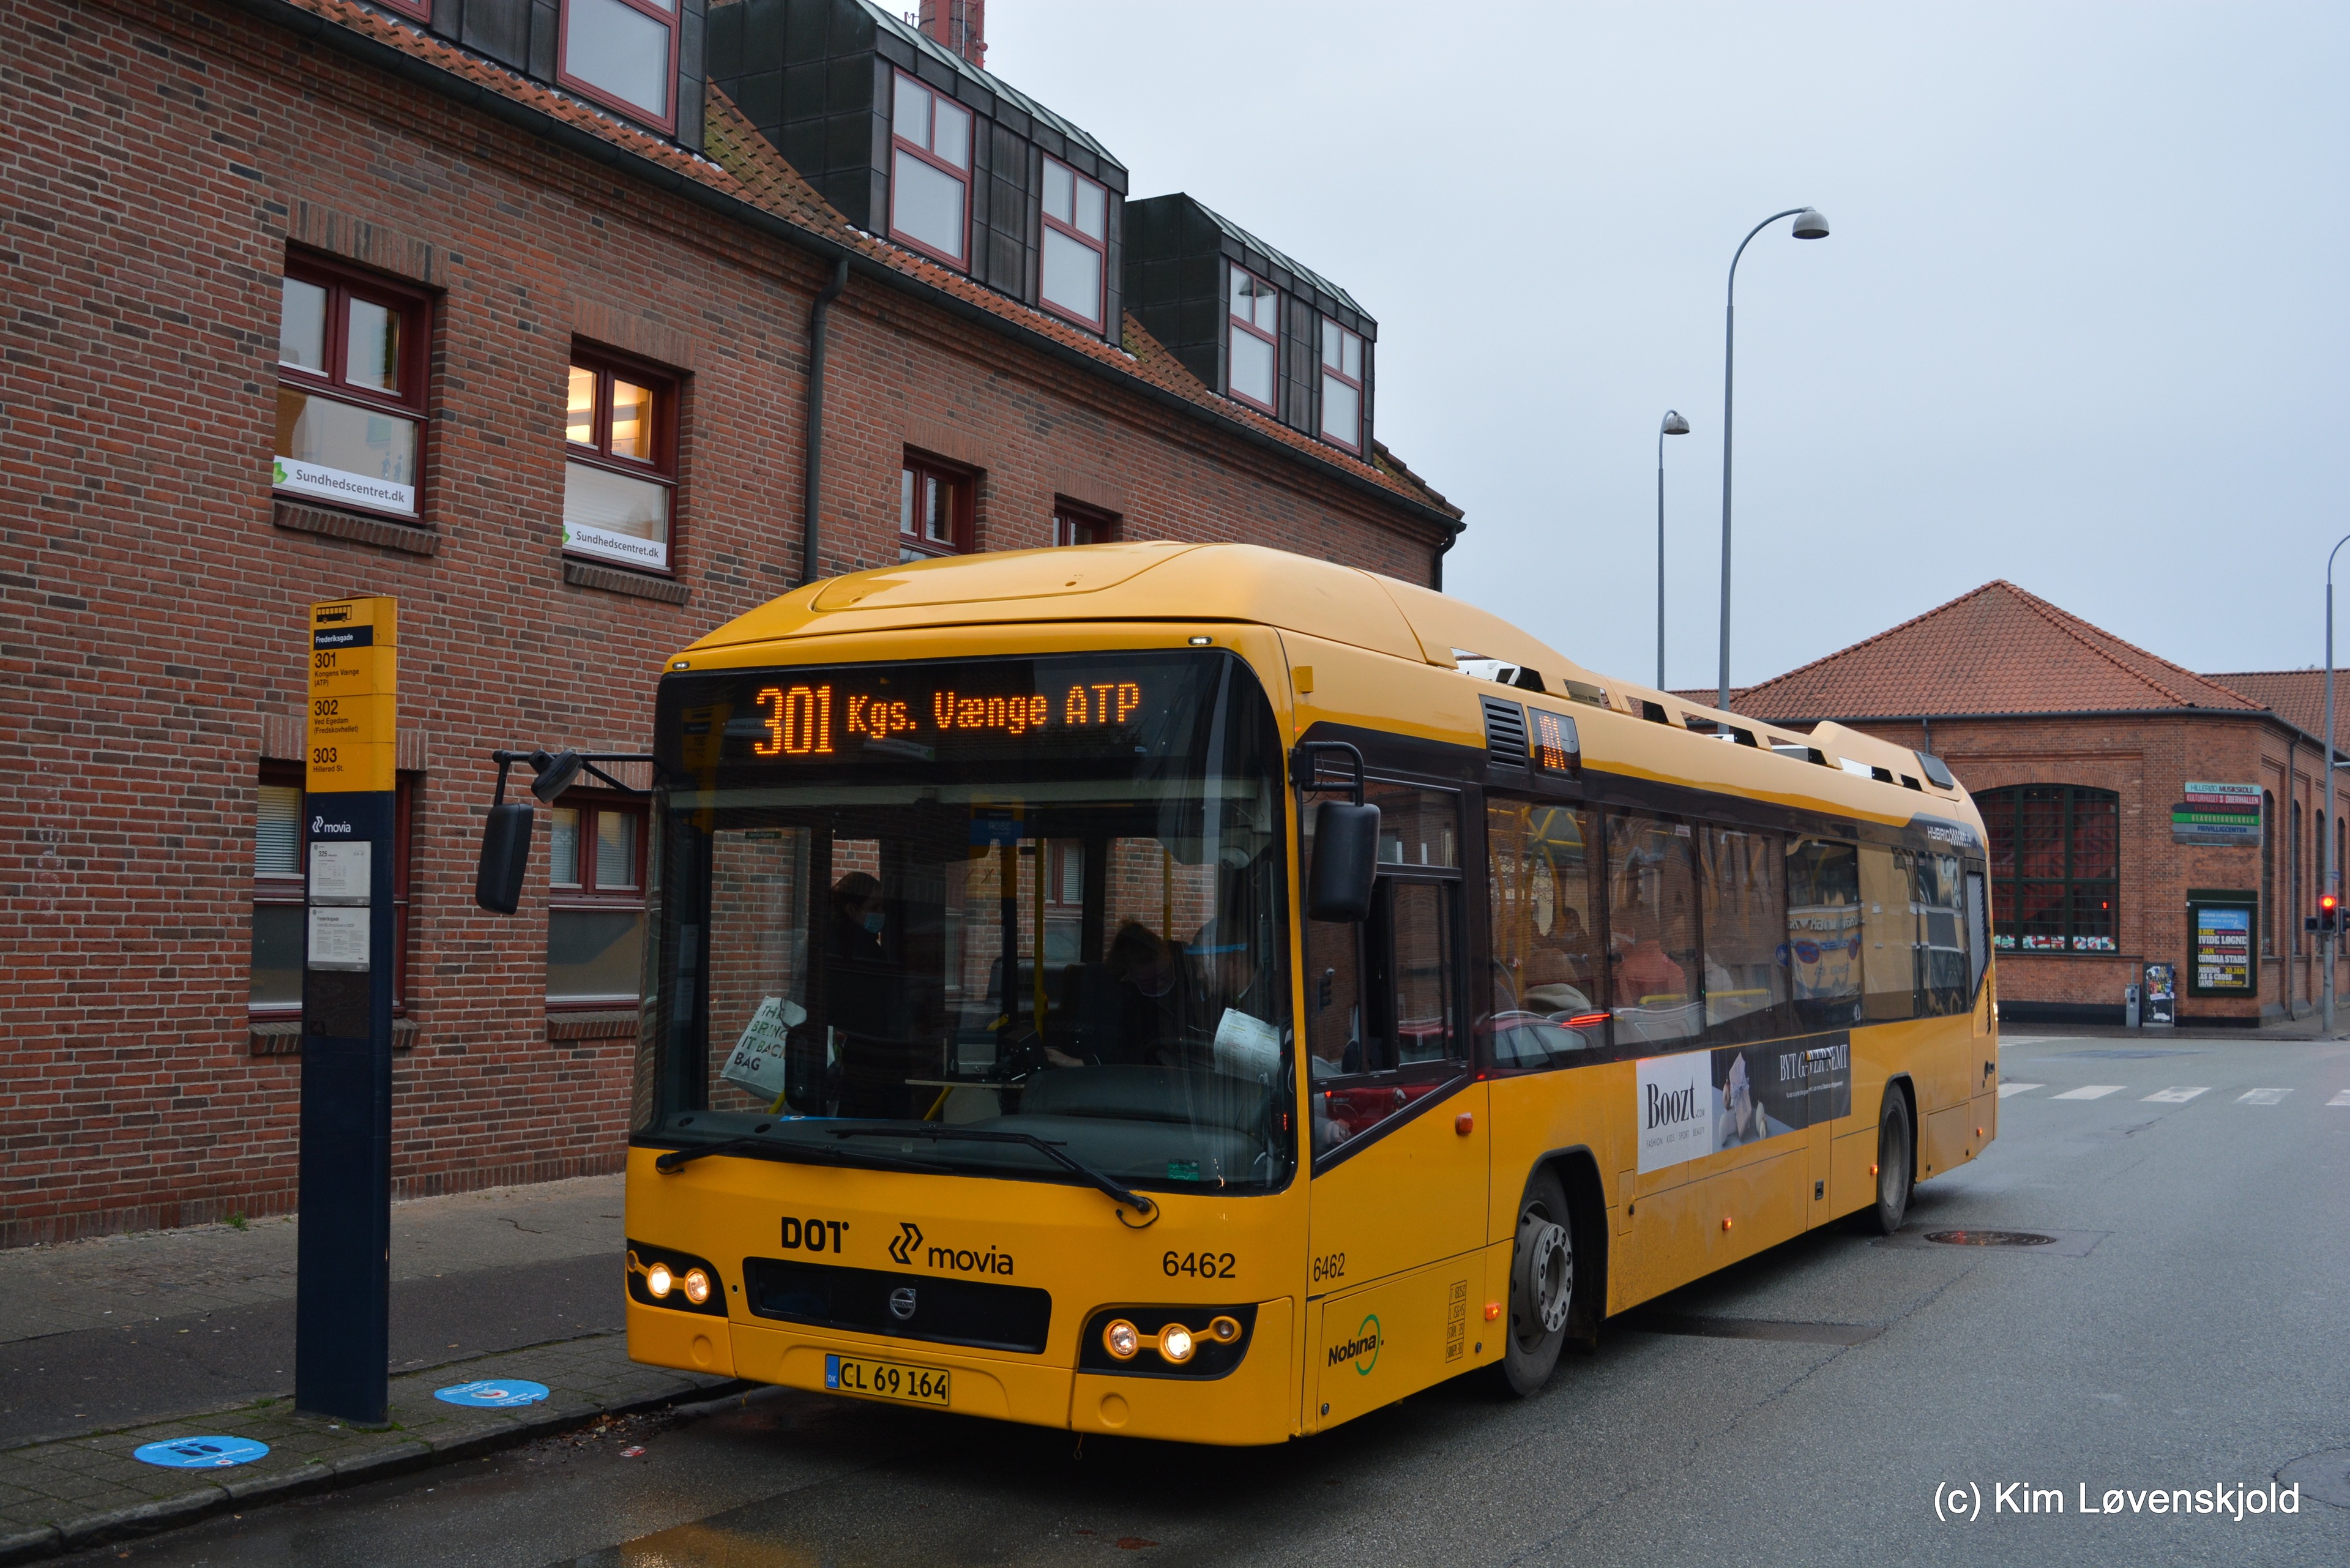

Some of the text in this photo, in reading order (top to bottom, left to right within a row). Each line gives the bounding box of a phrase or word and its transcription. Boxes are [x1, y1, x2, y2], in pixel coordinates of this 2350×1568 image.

[296, 469, 405, 502] Sundhedscentret.dk
[576, 531, 658, 558] Sundhedscentret.dk
[316, 634, 353, 643] Frederiksgade
[315, 652, 336, 668] 301
[315, 700, 338, 716] 302
[755, 685, 833, 755] 301
[849, 695, 916, 739] Kgs.
[934, 692, 1046, 734] Vænge
[1067, 683, 1139, 723] ATP
[313, 747, 337, 763] 303
[324, 821, 351, 832] movia
[1927, 826, 1950, 842] HYBRID
[742, 1036, 758, 1050] IT
[734, 1052, 761, 1071] BAG
[1780, 1053, 1796, 1081] BYT
[1826, 1044, 1848, 1072] NEMT
[1646, 1077, 1696, 1129] Boozt
[1646, 1137, 1663, 1148] FASHION
[1666, 1133, 1675, 1143] KIDS
[1679, 1130, 1689, 1140] SPORT
[781, 1217, 849, 1253] DOT
[928, 1245, 1013, 1275] movia
[1163, 1251, 1236, 1279] 6462
[1313, 1252, 1345, 1282] 6462
[1328, 1334, 1376, 1367] Nobina
[828, 1375, 837, 1383] DK
[841, 1362, 946, 1400] CL 69 164
